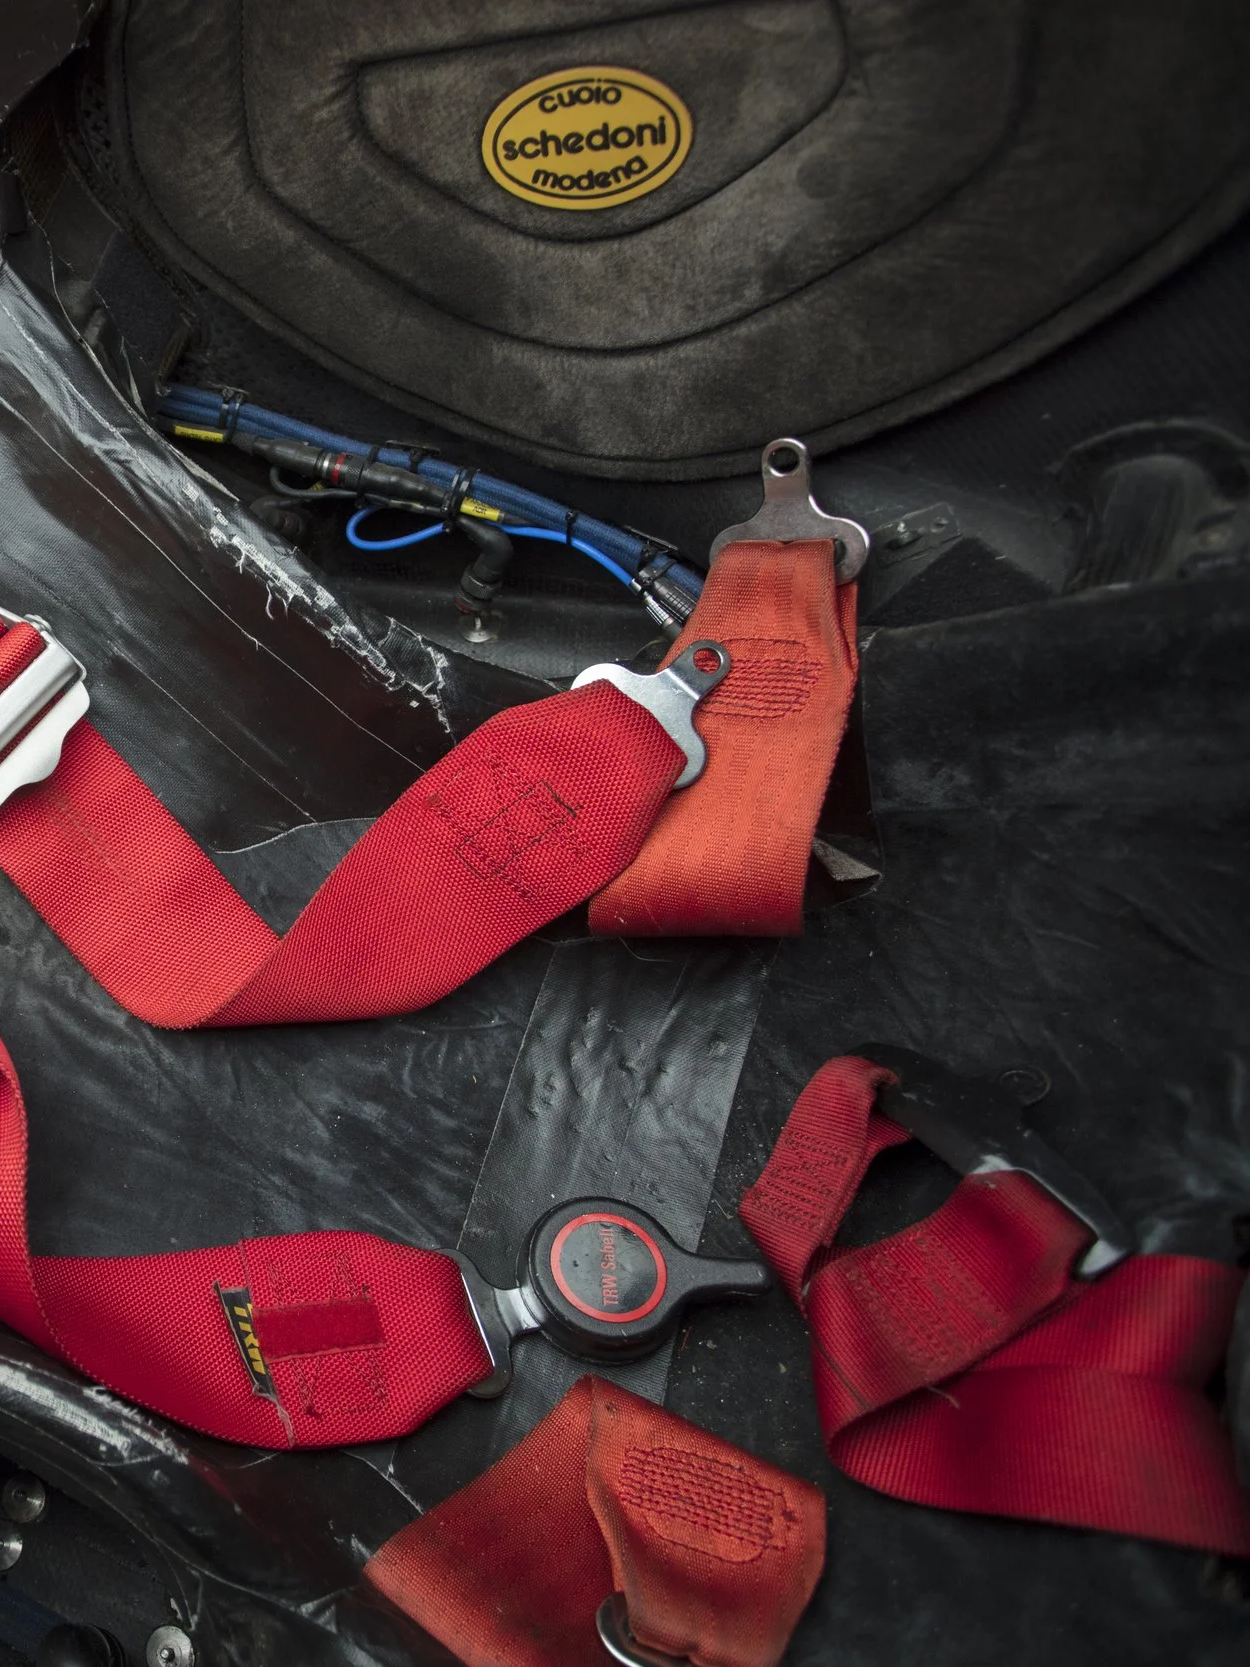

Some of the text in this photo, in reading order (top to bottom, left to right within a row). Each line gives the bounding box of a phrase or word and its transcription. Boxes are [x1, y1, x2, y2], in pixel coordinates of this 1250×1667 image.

[538, 78, 622, 113] cuoio
[502, 115, 667, 161] schedoni
[531, 155, 649, 192] modena
[602, 1274, 619, 1306] TRW
